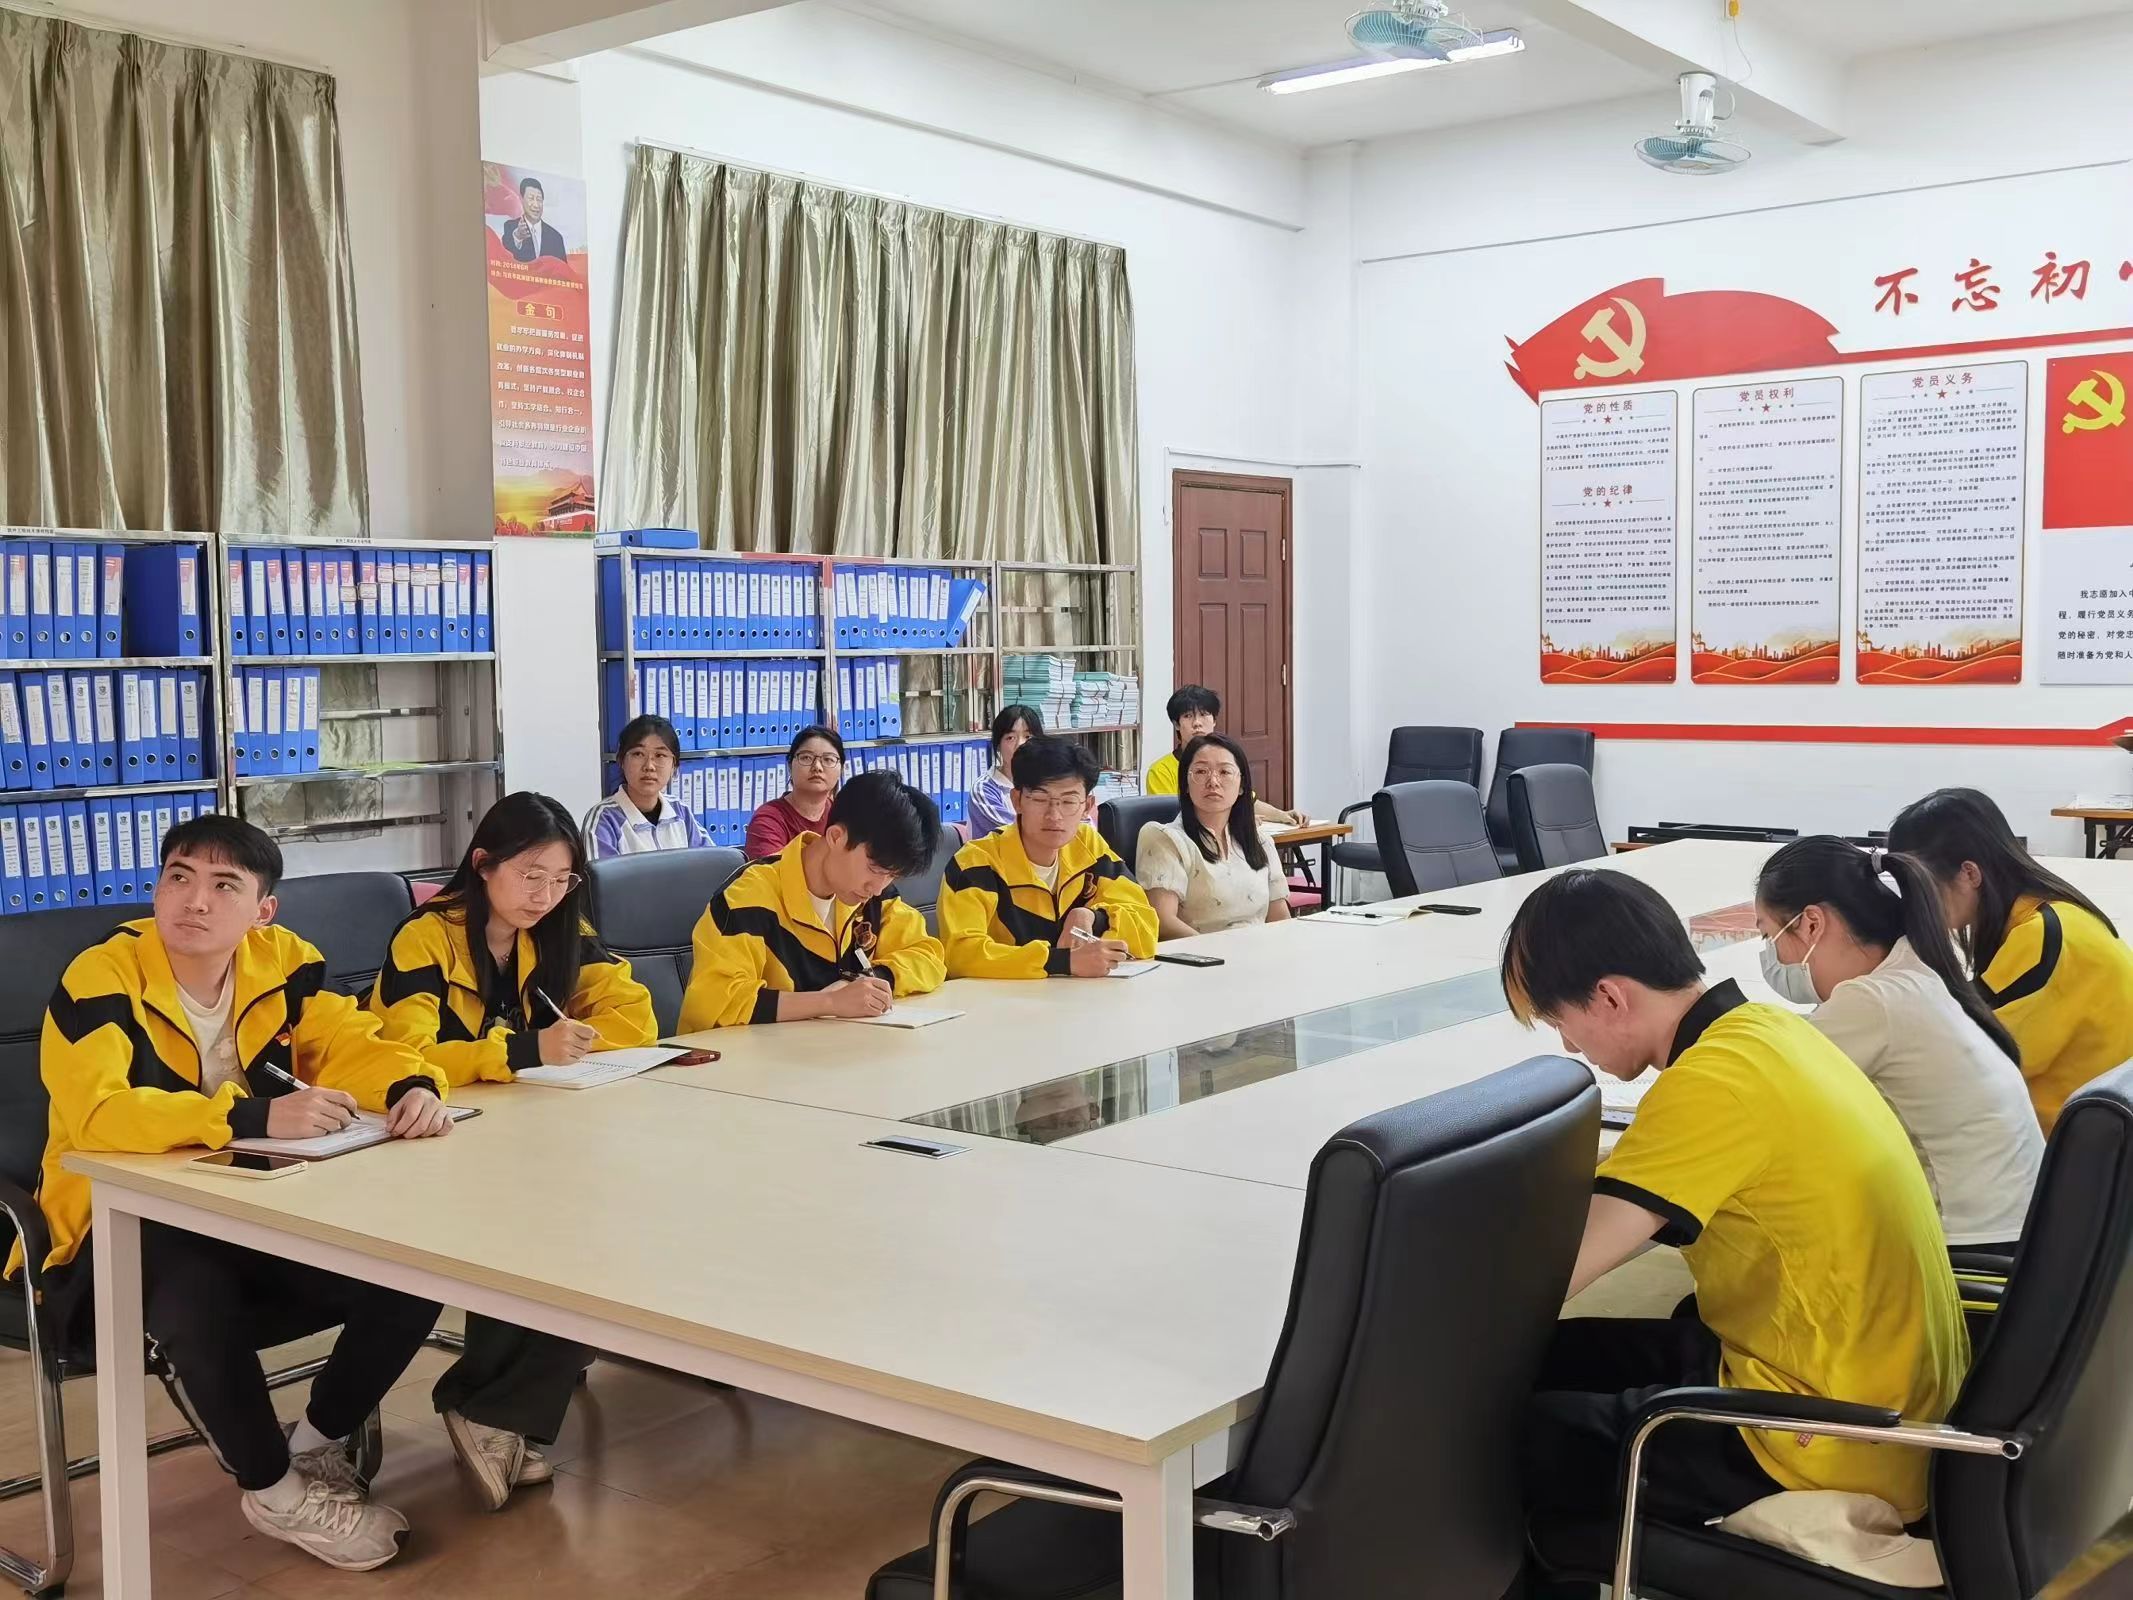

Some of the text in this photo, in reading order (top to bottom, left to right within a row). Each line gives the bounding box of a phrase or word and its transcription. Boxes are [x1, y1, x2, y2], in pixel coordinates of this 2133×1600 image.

[1874, 251, 2133, 315] 不忘初
[525, 303, 556, 319] 金句
[1912, 372, 1973, 389] 党员义务
[1739, 387, 1794, 403] 党员权利
[1583, 400, 1633, 414] 党的性质
[1583, 484, 1633, 497] 党的纪律
[2057, 650, 2133, 660] 随时准备为党和人
